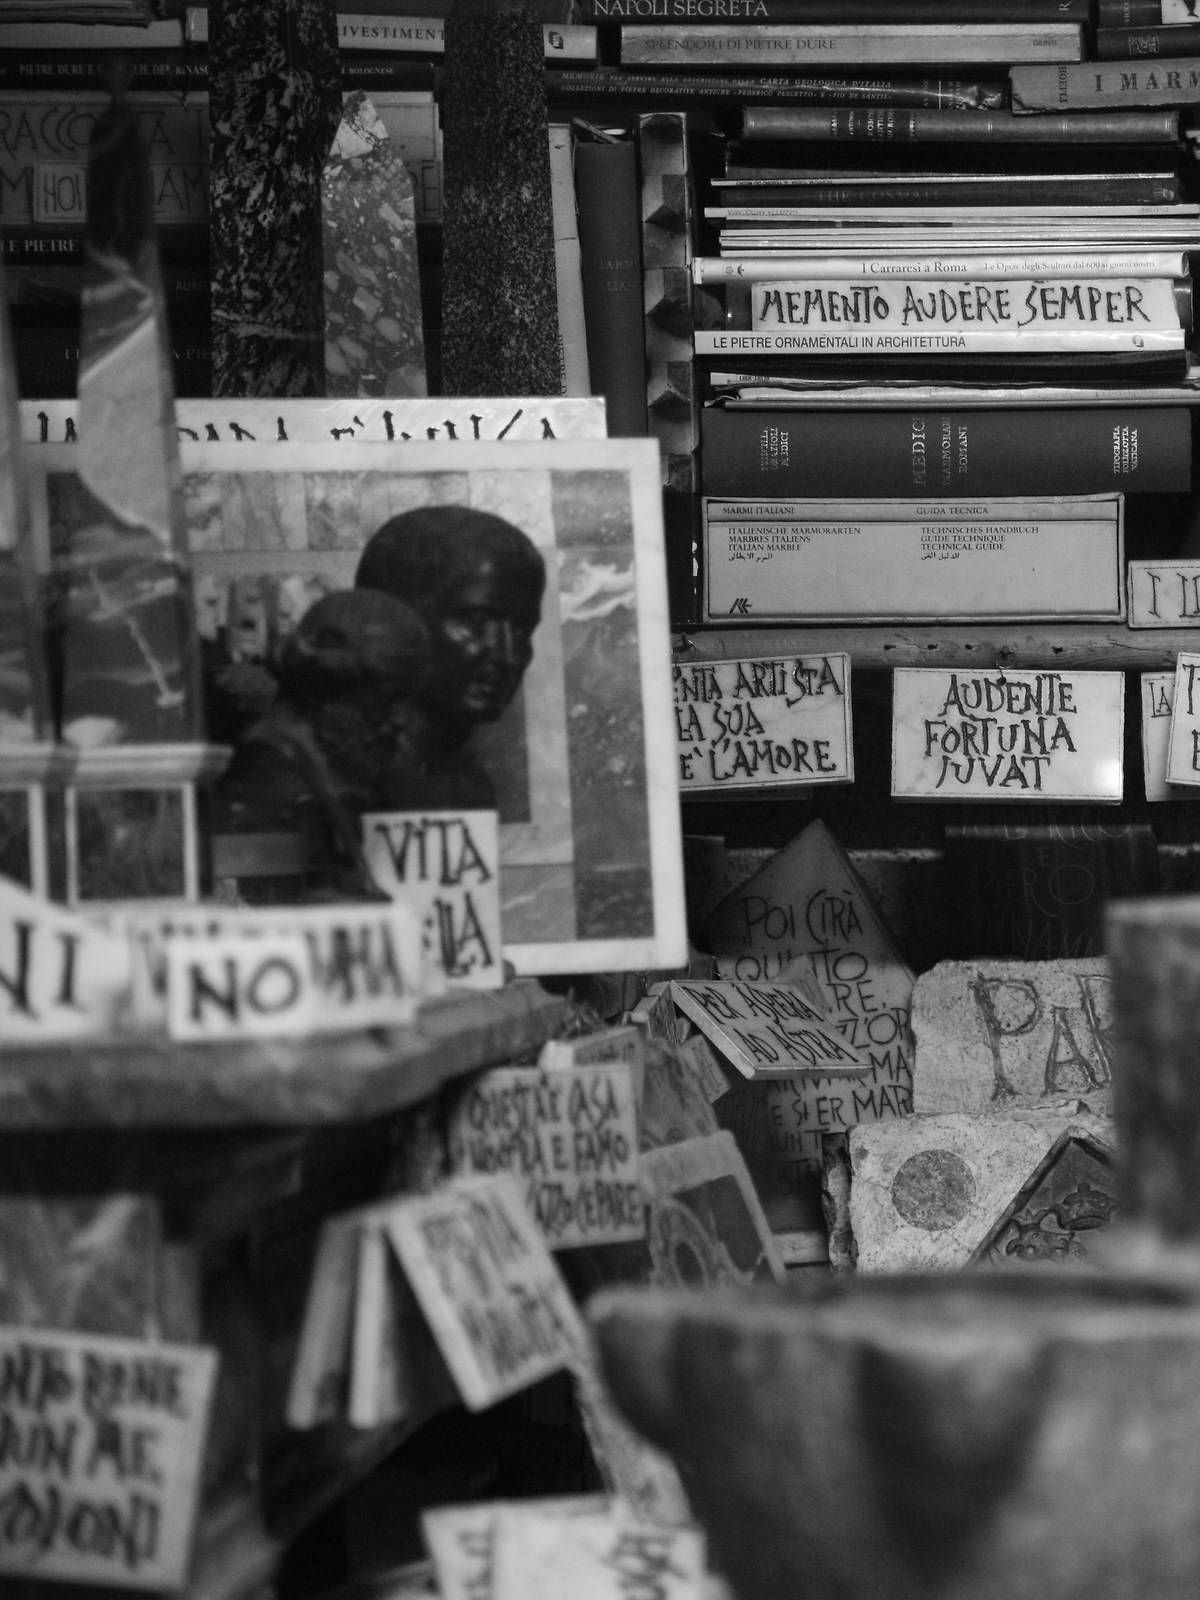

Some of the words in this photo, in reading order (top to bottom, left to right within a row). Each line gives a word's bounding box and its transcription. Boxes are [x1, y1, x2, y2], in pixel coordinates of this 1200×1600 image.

[594, 0, 670, 17] NAPOLI
[674, 0, 769, 17] SEGRETA
[644, 38, 723, 50] SPLENDORI
[726, 38, 739, 50] DI
[742, 38, 792, 50] PIETRE
[796, 38, 837, 50] DURE
[760, 77, 789, 86] CARTA
[795, 79, 846, 87] GEOLOGICA
[852, 80, 892, 88] D'ITALIA
[1095, 73, 1104, 92] I
[24, 239, 79, 252] PIETRE
[861, 263, 866, 274] I
[870, 263, 922, 274] Carraresi
[934, 262, 967, 273] Roma
[984, 263, 995, 271] Le
[996, 264, 1020, 273] Opere
[1021, 262, 1040, 273] degli
[1041, 262, 1071, 271] Scultori
[1073, 261, 1084, 270] dal
[1109, 260, 1132, 271] giorni
[1133, 259, 1155, 268] nostri
[760, 285, 889, 325] MEMENTO
[902, 284, 1011, 327] AUDERE
[1016, 284, 1151, 329] SEMPER
[713, 336, 727, 348] LE
[731, 336, 771, 348] PIETRE
[775, 336, 858, 348] ORNAMENTALI
[861, 336, 874, 348] IN
[876, 336, 966, 348] ARCHITETTURA
[912, 416, 926, 486] MEDICI
[958, 425, 968, 474] ROMANI
[722, 506, 753, 515] MARMI
[755, 506, 795, 515] ITALIANI
[916, 507, 946, 515] GUIDA
[949, 507, 988, 515] TECNICA
[728, 527, 788, 535] ITALIENISCHE
[791, 527, 861, 535] MARMORARTEN
[921, 526, 983, 534] TECHNISCHES
[985, 526, 1039, 534] HANDBUCH
[728, 535, 769, 543] MARBRES
[771, 535, 811, 543] ITALIENS
[728, 543, 764, 551] ITALIAN
[767, 543, 801, 551] MARBLE
[920, 535, 949, 543] GUIDE
[952, 535, 1006, 543] TECHNIQUE
[920, 543, 973, 551] TECHNICAL
[975, 543, 1005, 551] GUIDE
[1148, 571, 1161, 616] I
[734, 657, 844, 708] ARTISTA
[938, 673, 1077, 719] AUDENTE
[712, 701, 766, 748] SUA
[924, 714, 1077, 757] FORTUNA
[709, 736, 836, 781] L'AMORE
[374, 818, 493, 886] VITA
[741, 895, 796, 941] POI
[682, 986, 748, 1025] PER
[731, 982, 825, 1024] ASPERA
[733, 1027, 780, 1063] AD
[766, 1020, 860, 1066] ASTRA
